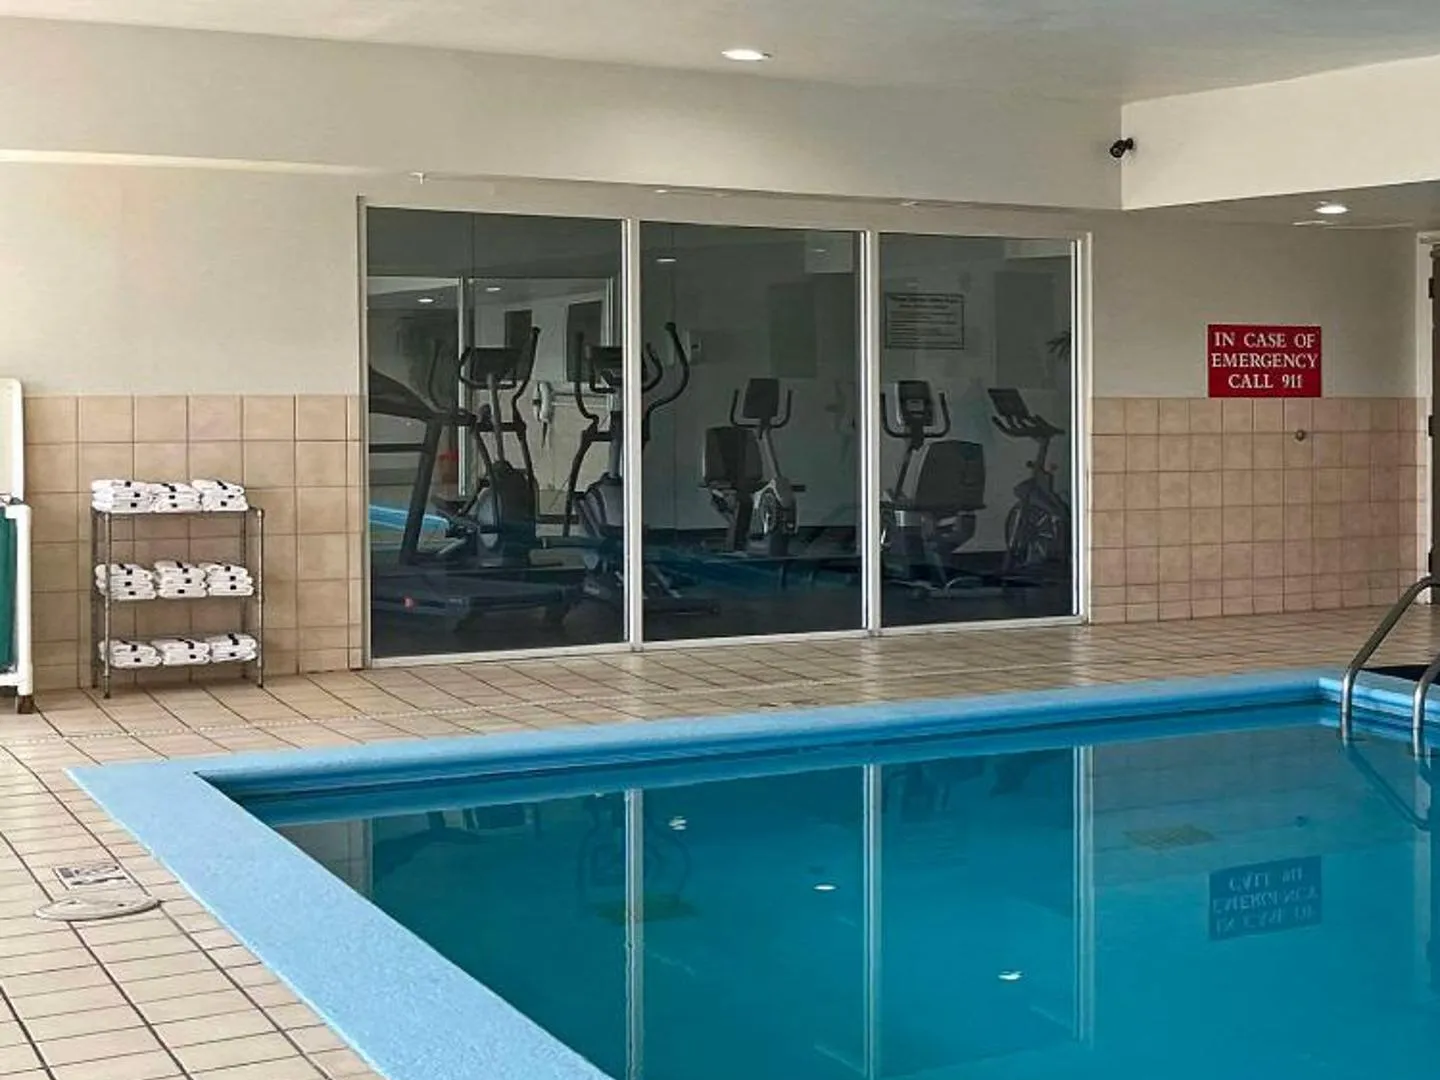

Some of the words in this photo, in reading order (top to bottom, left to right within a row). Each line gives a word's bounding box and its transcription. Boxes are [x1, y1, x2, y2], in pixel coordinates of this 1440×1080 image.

[1214, 332, 1235, 347] IN
[1244, 332, 1287, 348] CASE
[1294, 333, 1316, 348] OF
[1211, 353, 1318, 368] EMERGENCY
[1228, 374, 1273, 389] CALL
[1282, 374, 1303, 389] 911
